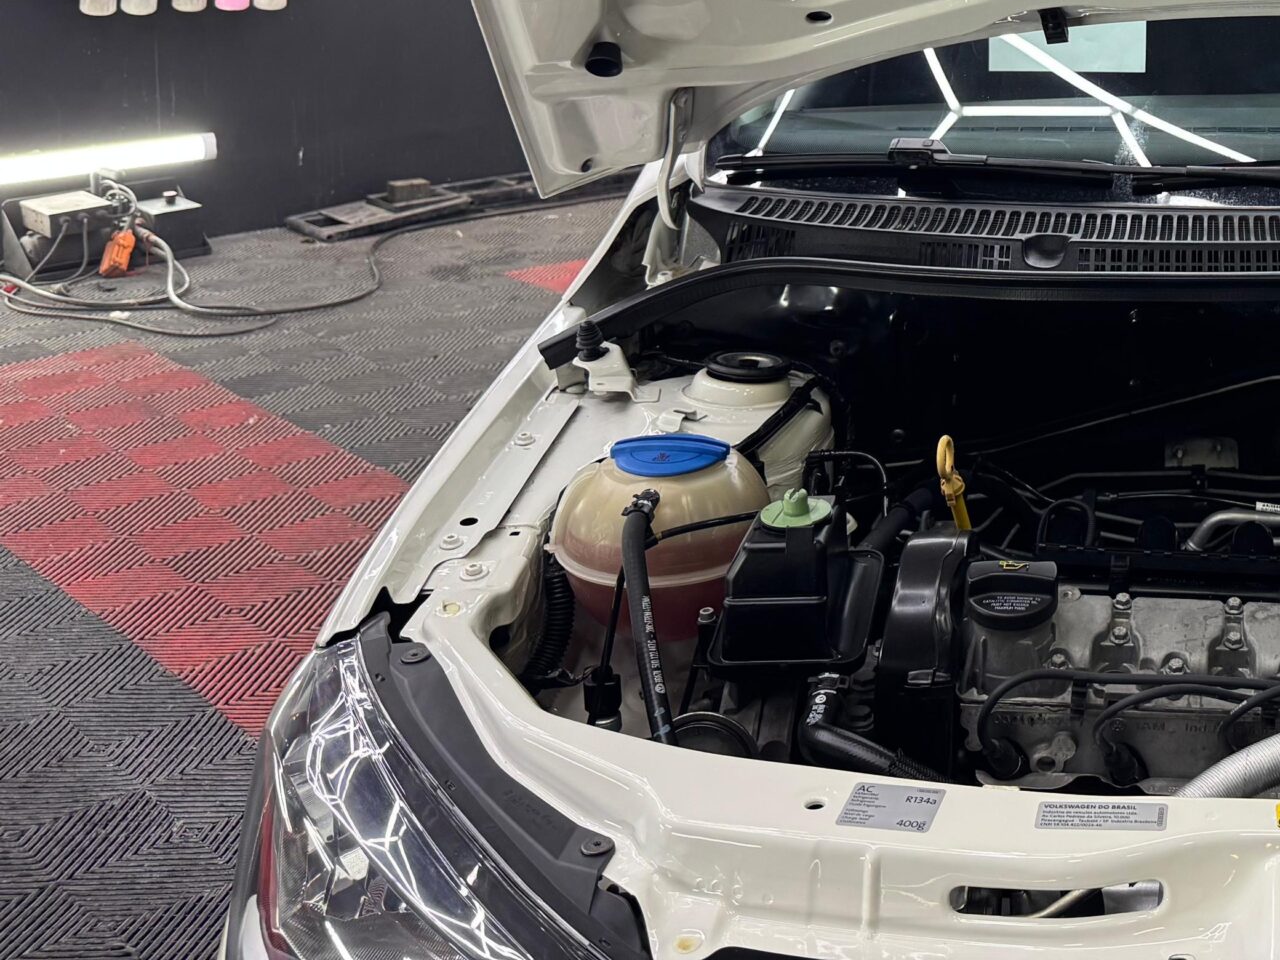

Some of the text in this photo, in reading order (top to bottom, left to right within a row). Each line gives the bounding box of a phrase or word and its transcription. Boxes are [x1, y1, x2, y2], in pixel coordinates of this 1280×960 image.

[857, 785, 876, 793] AC
[905, 795, 937, 805] R134a
[896, 819, 926, 831] 400g
